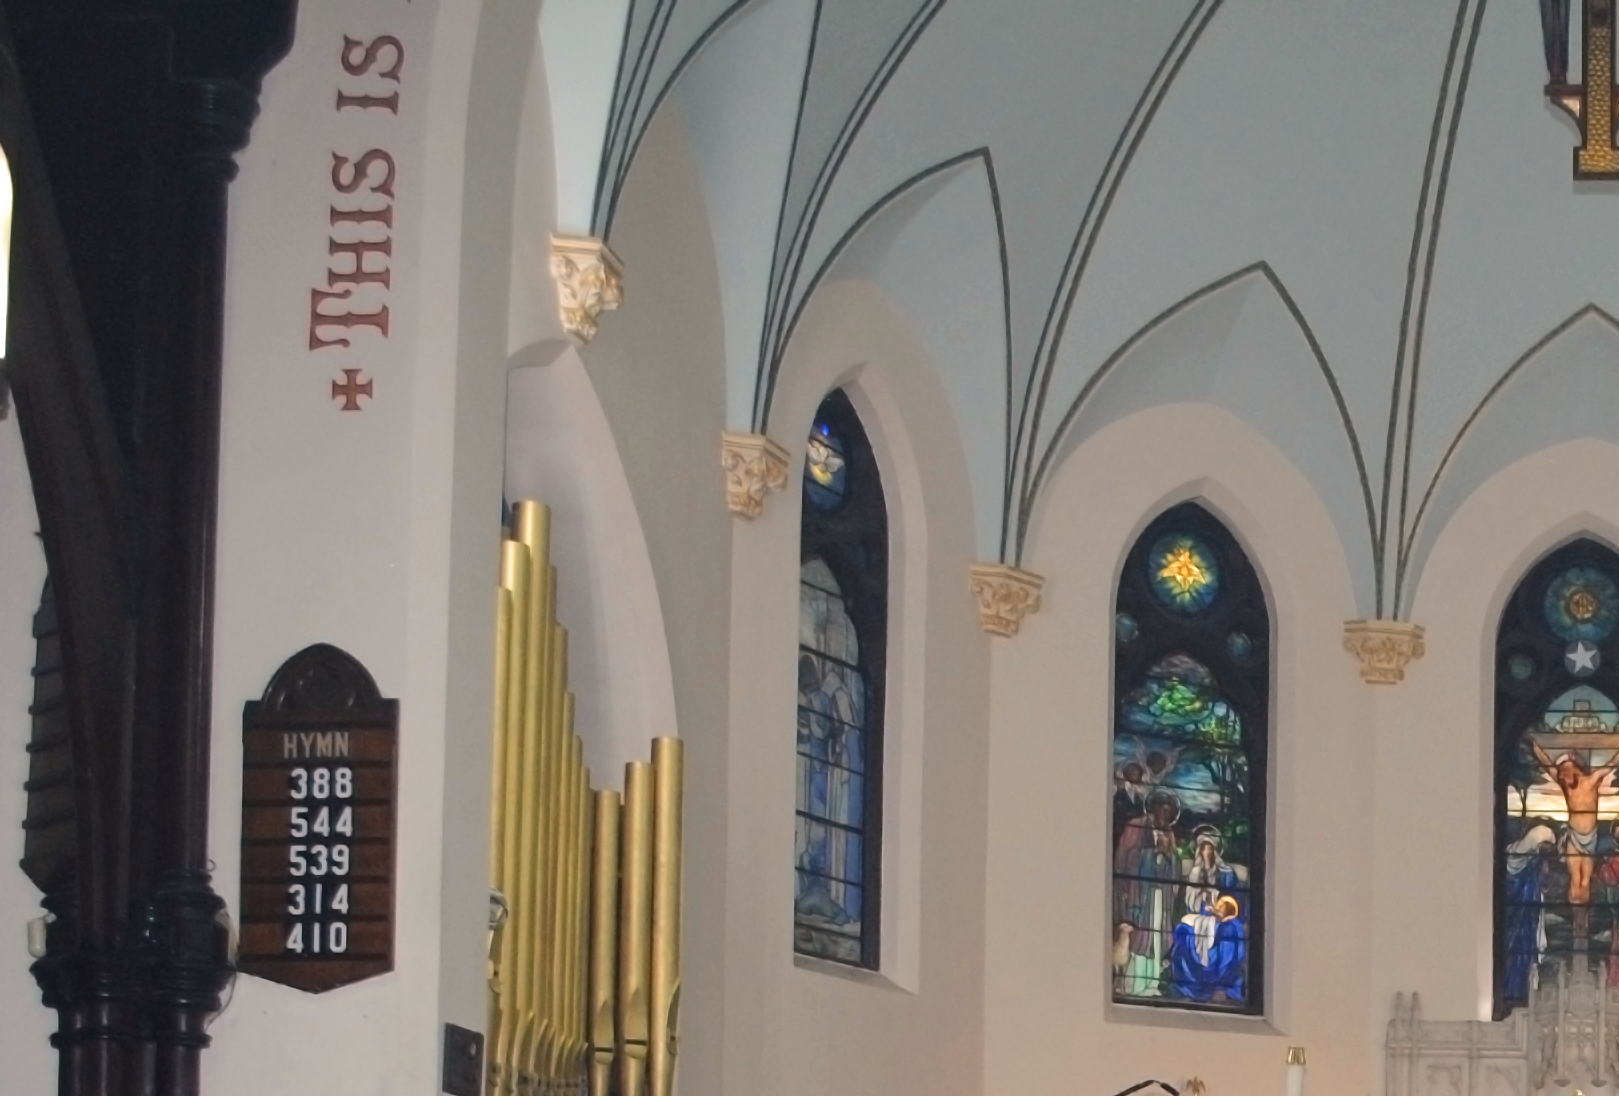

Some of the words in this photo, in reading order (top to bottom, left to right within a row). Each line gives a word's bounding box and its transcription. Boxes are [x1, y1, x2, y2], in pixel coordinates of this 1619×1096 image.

[336, 33, 405, 116] IS
[309, 148, 396, 351] THIS
[283, 731, 349, 758] HYMN
[290, 767, 353, 799] 388
[290, 806, 353, 837] 544
[289, 844, 350, 876] 539
[287, 883, 349, 915] 314
[286, 922, 347, 953] 410
